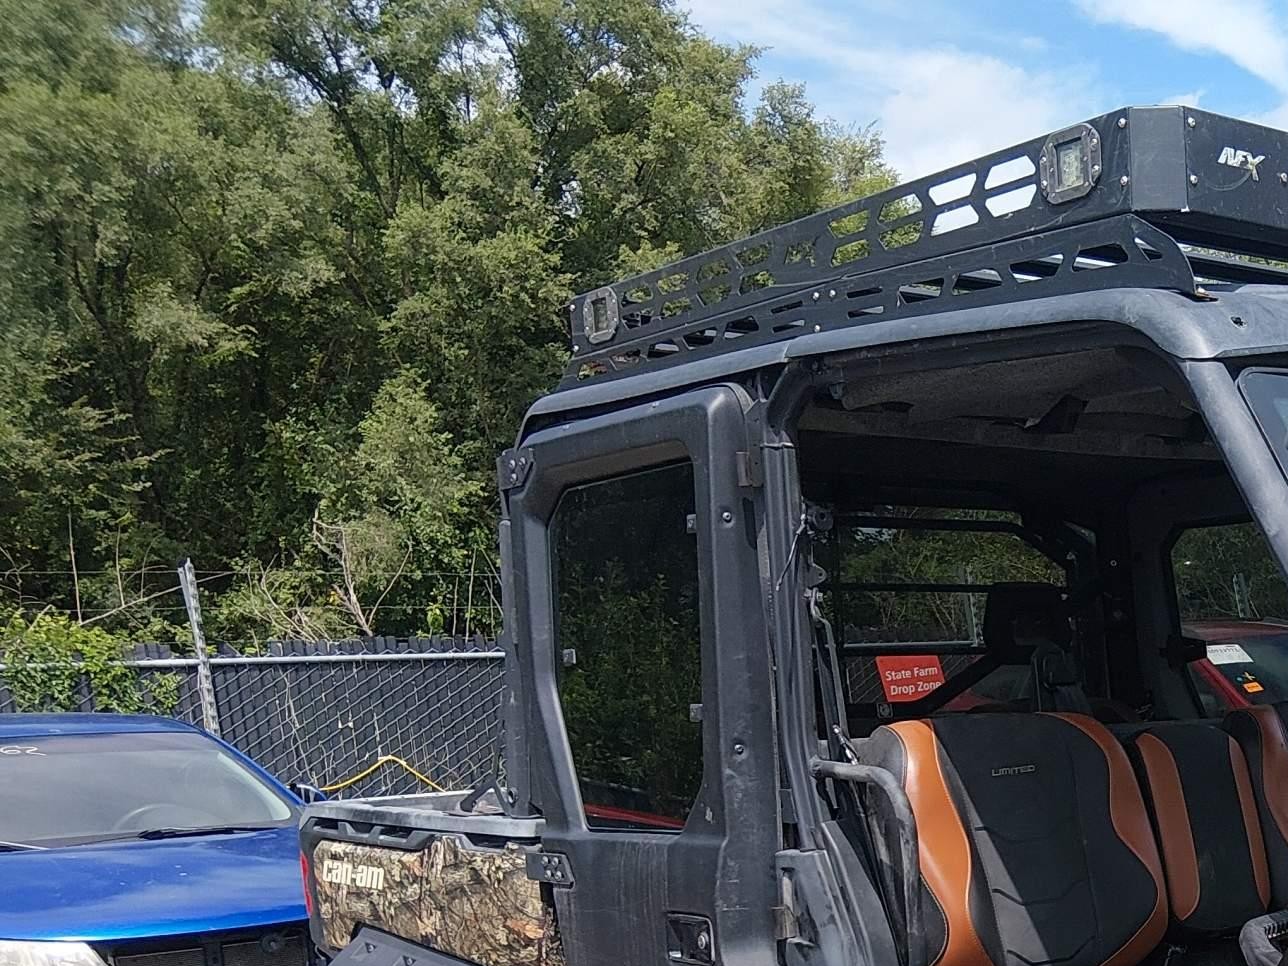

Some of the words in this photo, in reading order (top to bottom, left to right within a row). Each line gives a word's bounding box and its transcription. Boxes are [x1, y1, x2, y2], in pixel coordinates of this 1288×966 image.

[885, 670, 912, 681] State
[914, 667, 938, 678] Farm
[890, 684, 915, 696] Drop
[991, 764, 1036, 777] LIMITED
